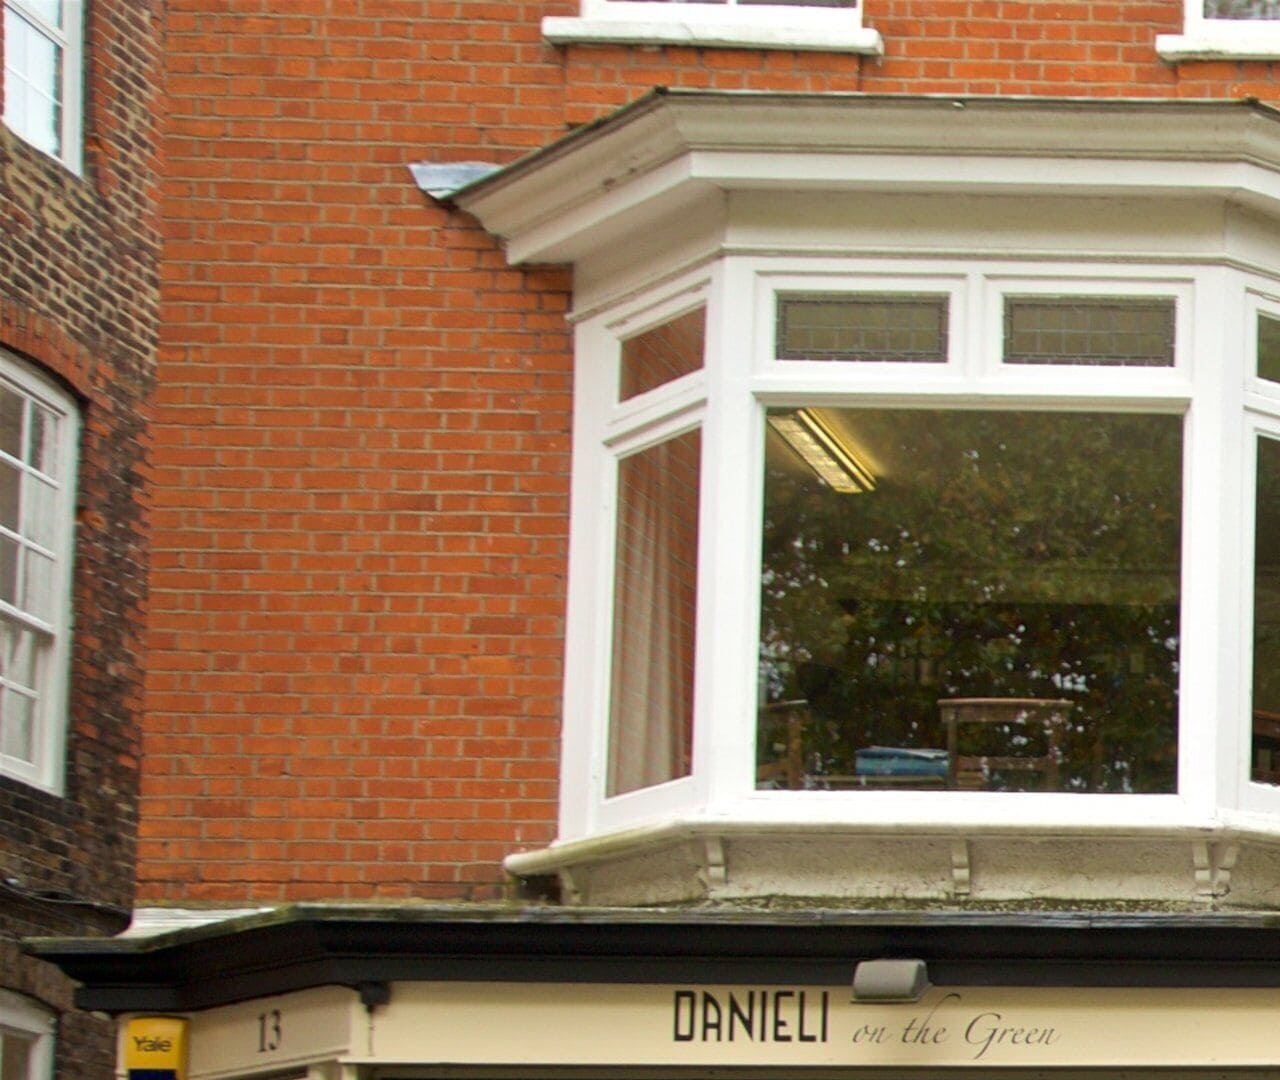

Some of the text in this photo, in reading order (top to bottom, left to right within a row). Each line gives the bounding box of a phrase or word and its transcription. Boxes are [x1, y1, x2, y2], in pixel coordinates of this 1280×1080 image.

[133, 1036, 173, 1053] Yale
[257, 1009, 282, 1052] 13
[673, 990, 1063, 1060] DANIELI on the Green
